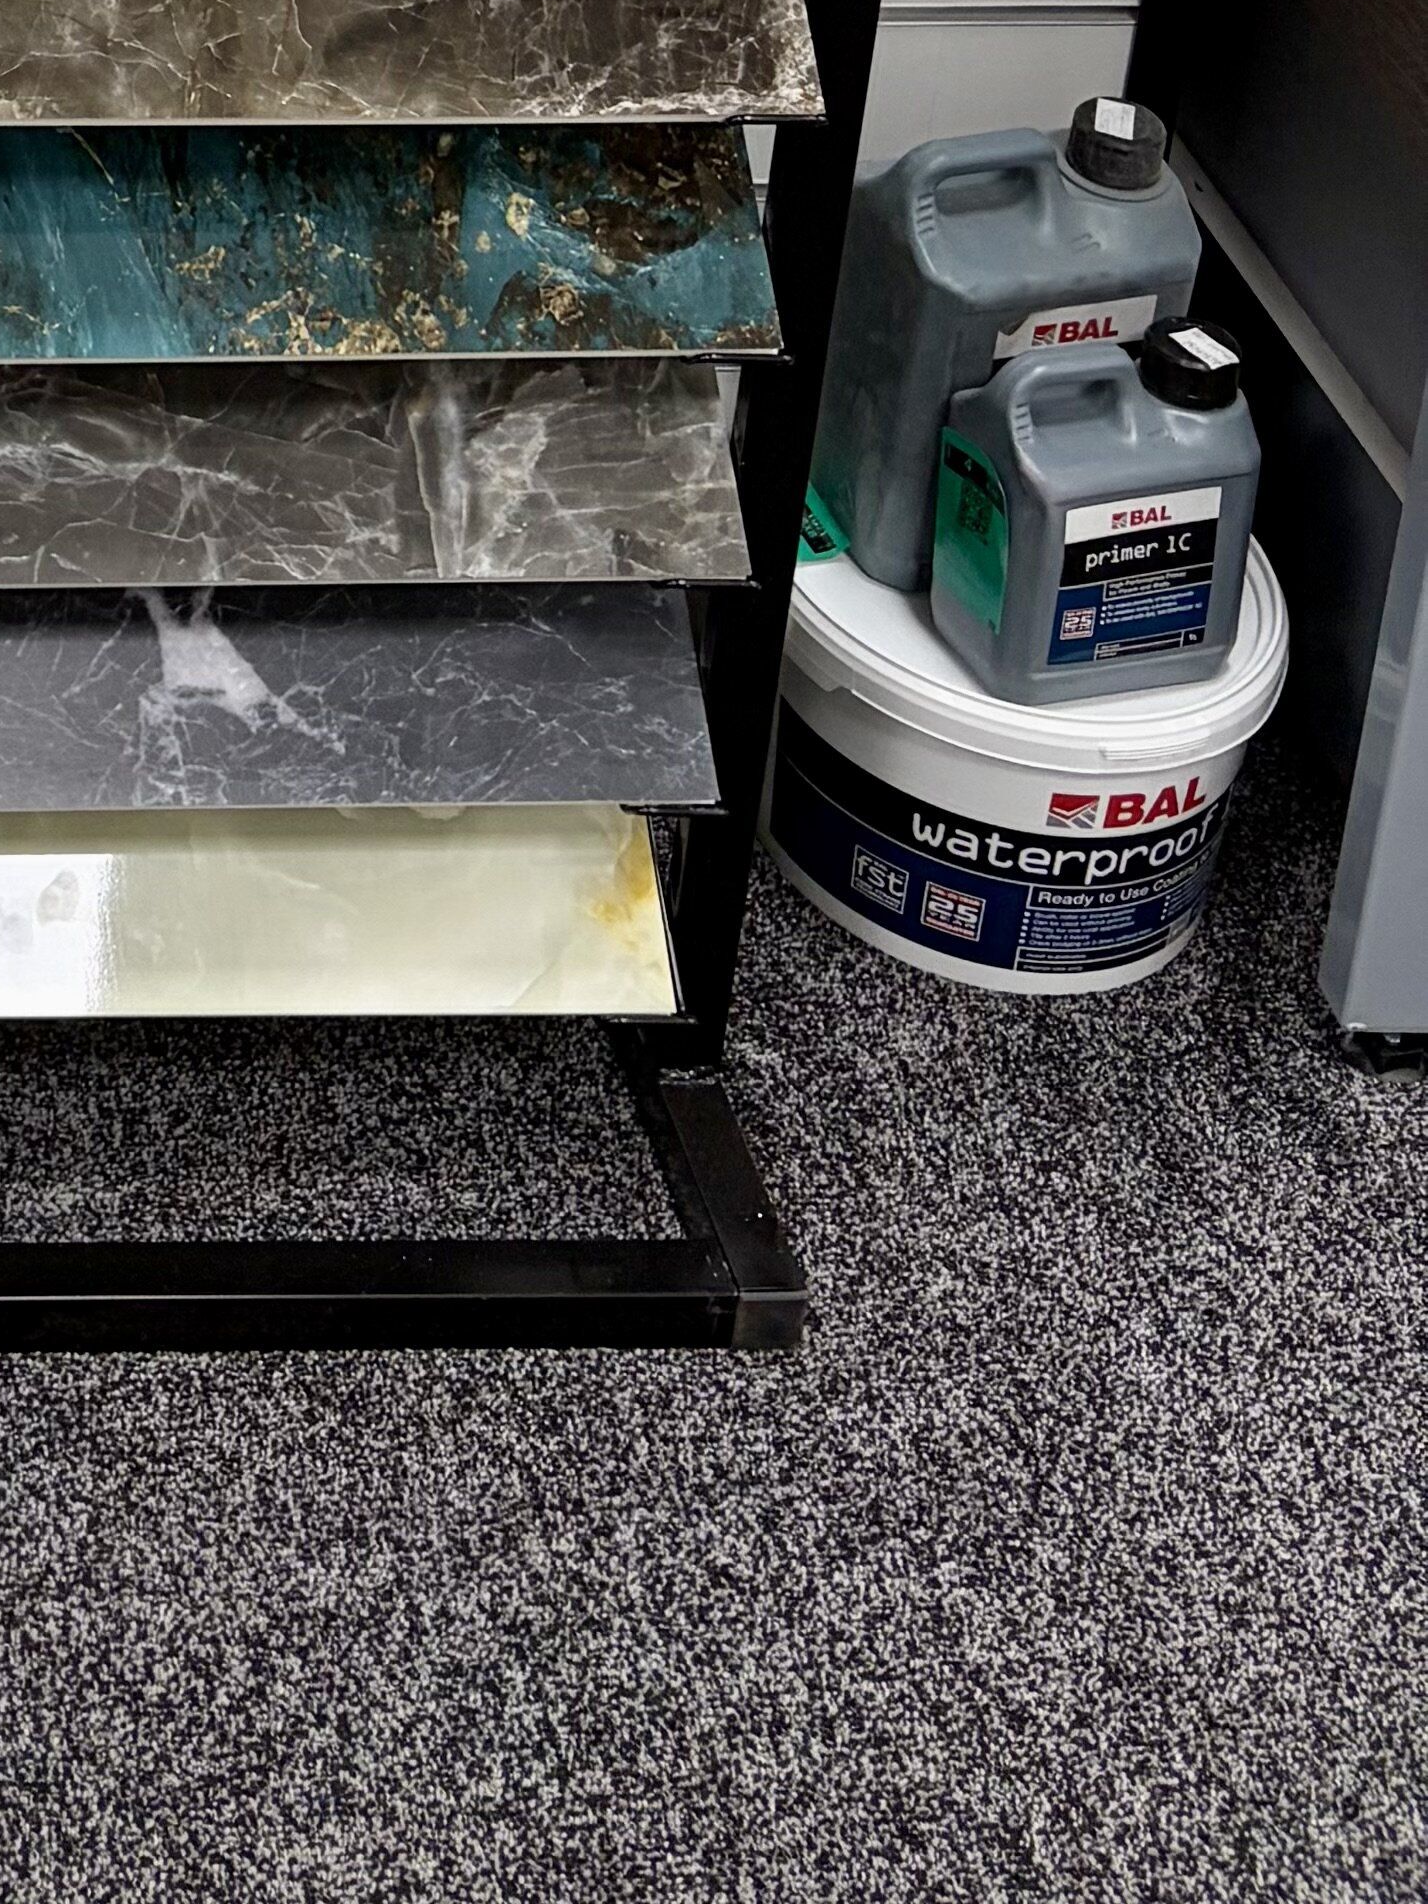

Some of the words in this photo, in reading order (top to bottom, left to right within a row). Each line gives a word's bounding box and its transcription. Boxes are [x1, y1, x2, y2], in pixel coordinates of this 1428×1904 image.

[1058, 316, 1119, 343] BAL
[1129, 504, 1172, 526] BAL
[1085, 539, 1159, 571] primer
[1167, 533, 1191, 553] 1C
[1102, 777, 1206, 828] BAL
[912, 811, 1218, 886] waterproof
[1038, 892, 1093, 907] Ready
[1099, 893, 1114, 903] to
[1120, 887, 1148, 901] Use
